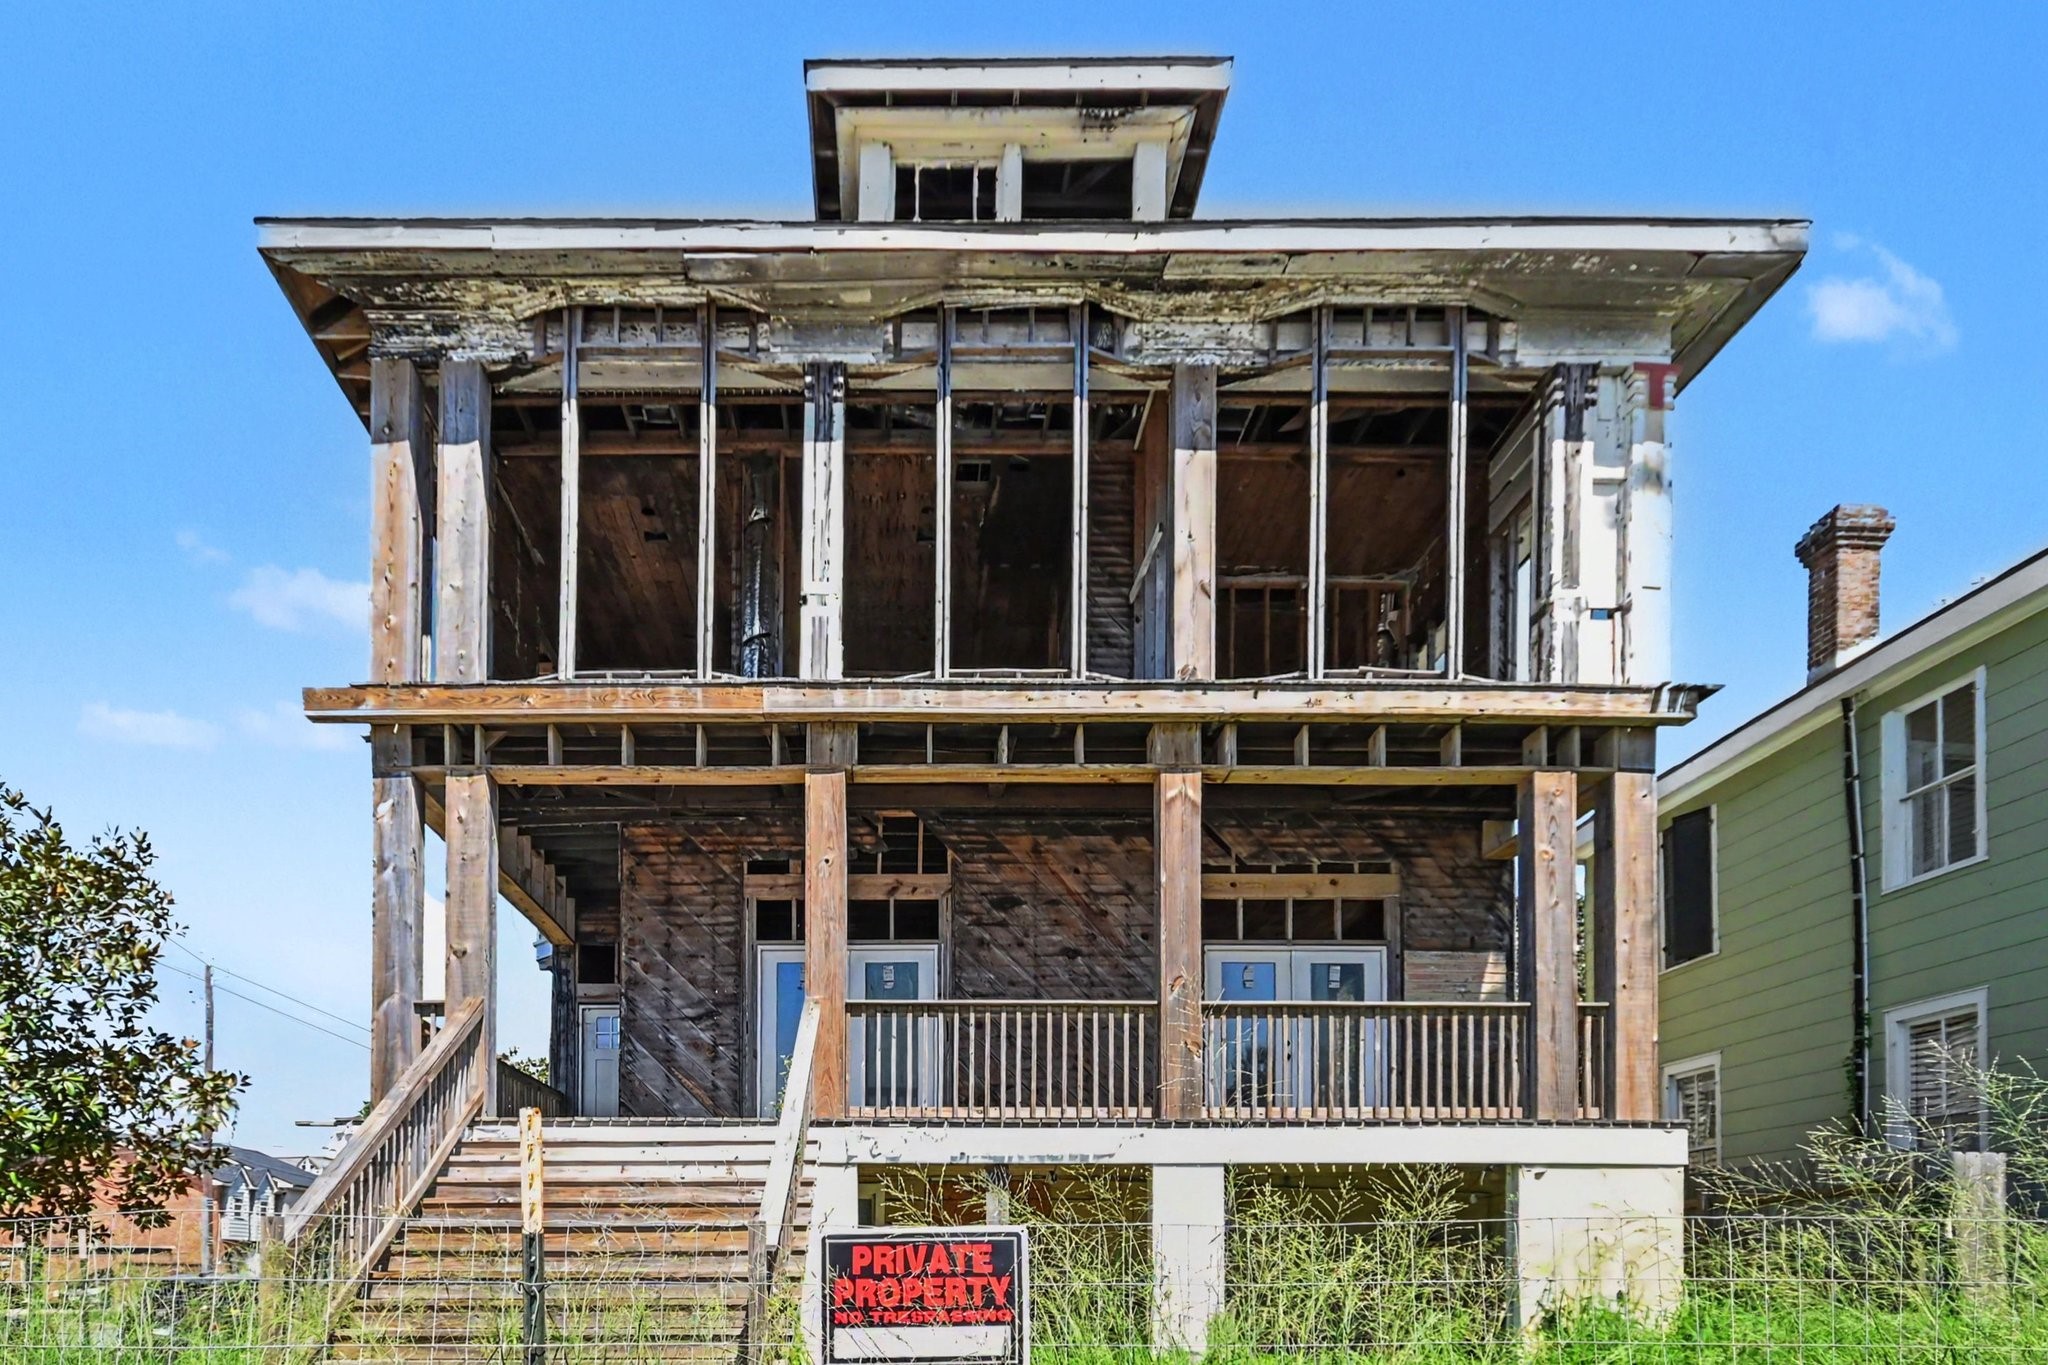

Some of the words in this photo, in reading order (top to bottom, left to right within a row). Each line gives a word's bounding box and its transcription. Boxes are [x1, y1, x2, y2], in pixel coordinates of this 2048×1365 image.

[852, 1243, 993, 1275] PRIVATE
[834, 1276, 1011, 1308] PROPERTY
[834, 1310, 864, 1325] NO
[871, 1308, 1014, 1325] TRESPASSING
